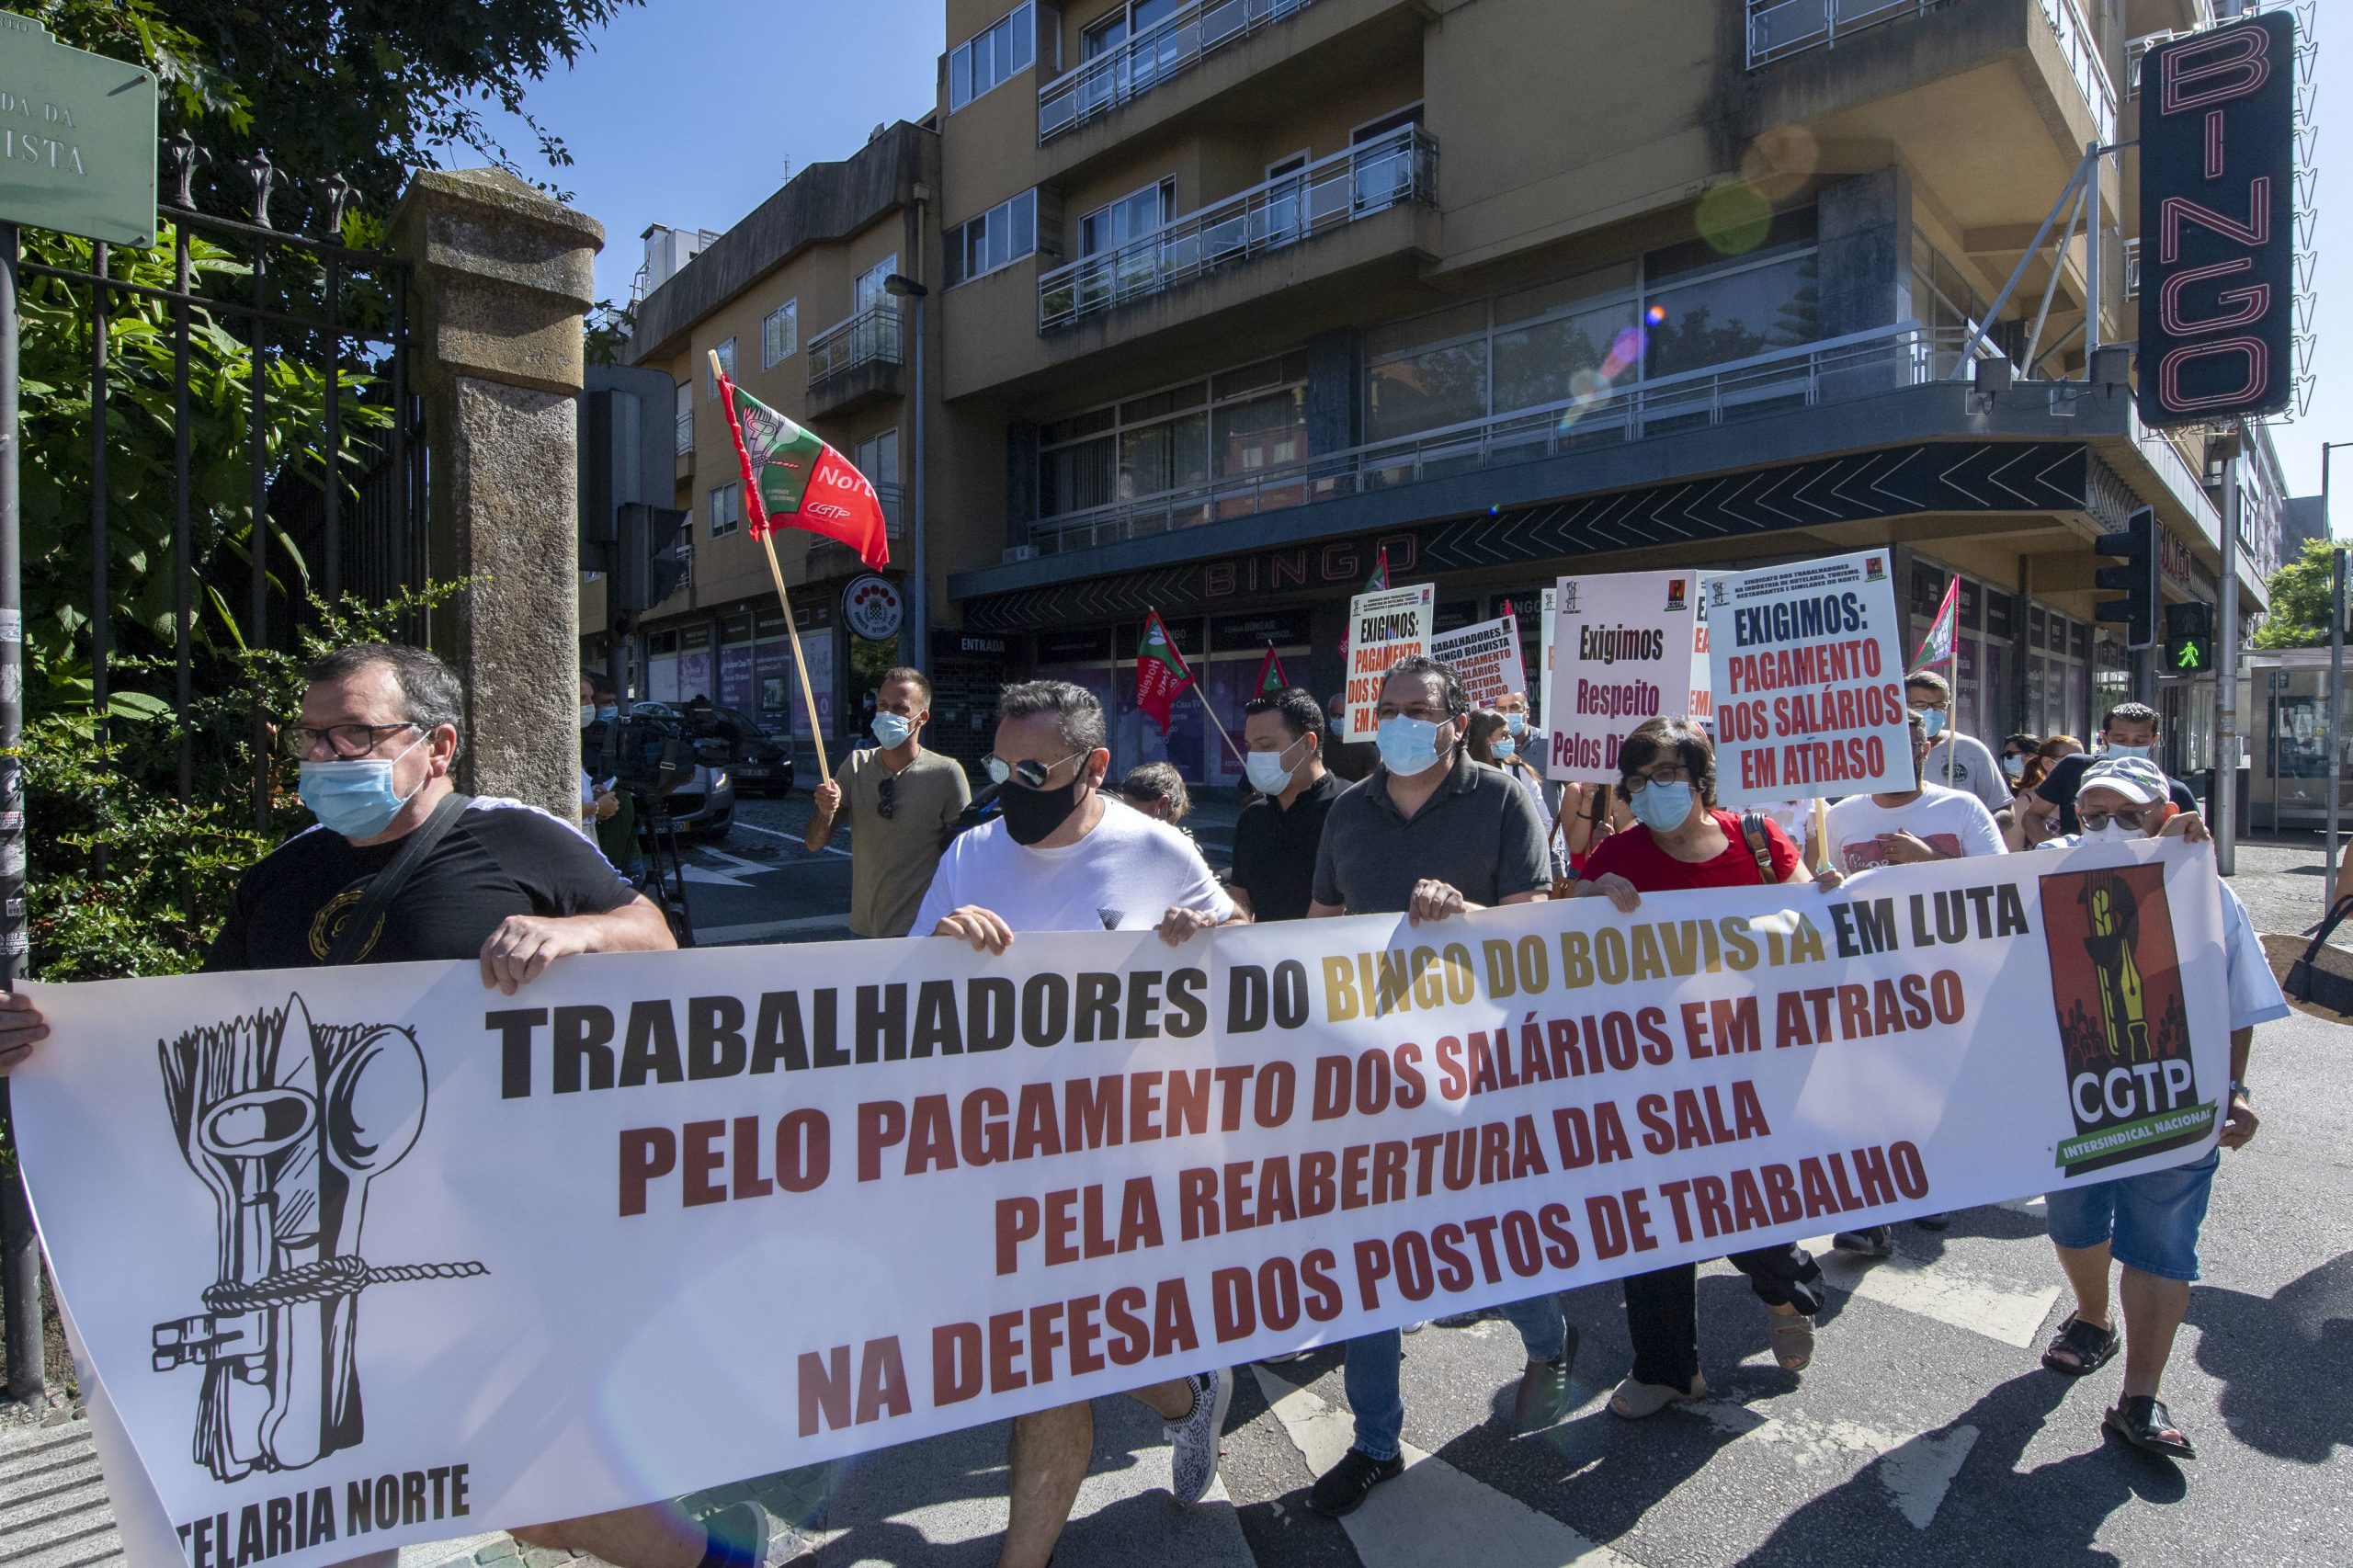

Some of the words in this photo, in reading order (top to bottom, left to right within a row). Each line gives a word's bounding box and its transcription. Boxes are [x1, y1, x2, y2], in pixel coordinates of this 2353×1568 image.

[45, 103, 75, 129] DA
[2160, 25, 2270, 413] BINGO
[1205, 534, 1416, 597] BINGO
[961, 637, 1006, 653] ENTRADA
[1360, 610, 1419, 643] EXIGIMOS:
[1579, 623, 1664, 665] Exigimos
[1734, 591, 1869, 648] EXIGIMOS:
[1456, 648, 1512, 671] PAGAMENTO
[1465, 636, 1510, 657] BOAVISTA
[1728, 637, 1881, 695] PAGAMENTO
[1347, 678, 1370, 704] DOS
[1472, 689, 1484, 701] DE
[1485, 684, 1508, 699] JOGO
[1576, 678, 1660, 720] Respeito
[1718, 699, 1769, 744] DOS
[1774, 683, 1904, 737] SALÁRIOS
[1354, 707, 1370, 733] EM
[1552, 731, 1601, 769] Pelos
[1741, 746, 1778, 790] EM
[1783, 734, 1885, 786] ATRASO
[485, 967, 1208, 1099] TRABALHADORES
[1226, 959, 1310, 1034] DO
[1321, 942, 1475, 1023] BINGO
[1482, 935, 1550, 999] DO
[1560, 912, 1826, 990] BOAVISTA
[1827, 897, 1899, 959] EM
[1909, 882, 2029, 948] LUTA
[619, 1108, 831, 1218] PELO
[857, 1061, 1296, 1183] PAGAMENTO
[1312, 1042, 1427, 1121] DOS
[1436, 1006, 1674, 1102] SALÁRIOS
[1679, 995, 1762, 1060] EM
[1776, 969, 1966, 1049] ATRASO
[2072, 1058, 2192, 1123] CGTP
[2063, 1125, 2154, 1159] INTERSINDICAL
[2154, 1108, 2212, 1134] NACIONAL
[995, 1176, 1165, 1277] PELA
[1179, 1114, 1550, 1243] REABERTURA
[1552, 1099, 1633, 1171] DA
[1637, 1079, 1772, 1155] SALA
[797, 1335, 913, 1438] NA
[931, 1277, 1199, 1408] DEFESA
[1211, 1248, 1343, 1344] DOS
[1353, 1203, 1580, 1312] POSTOS
[1585, 1187, 1658, 1261] DE
[1659, 1141, 1930, 1244] TRABALHO
[347, 1463, 470, 1538] NORTE
